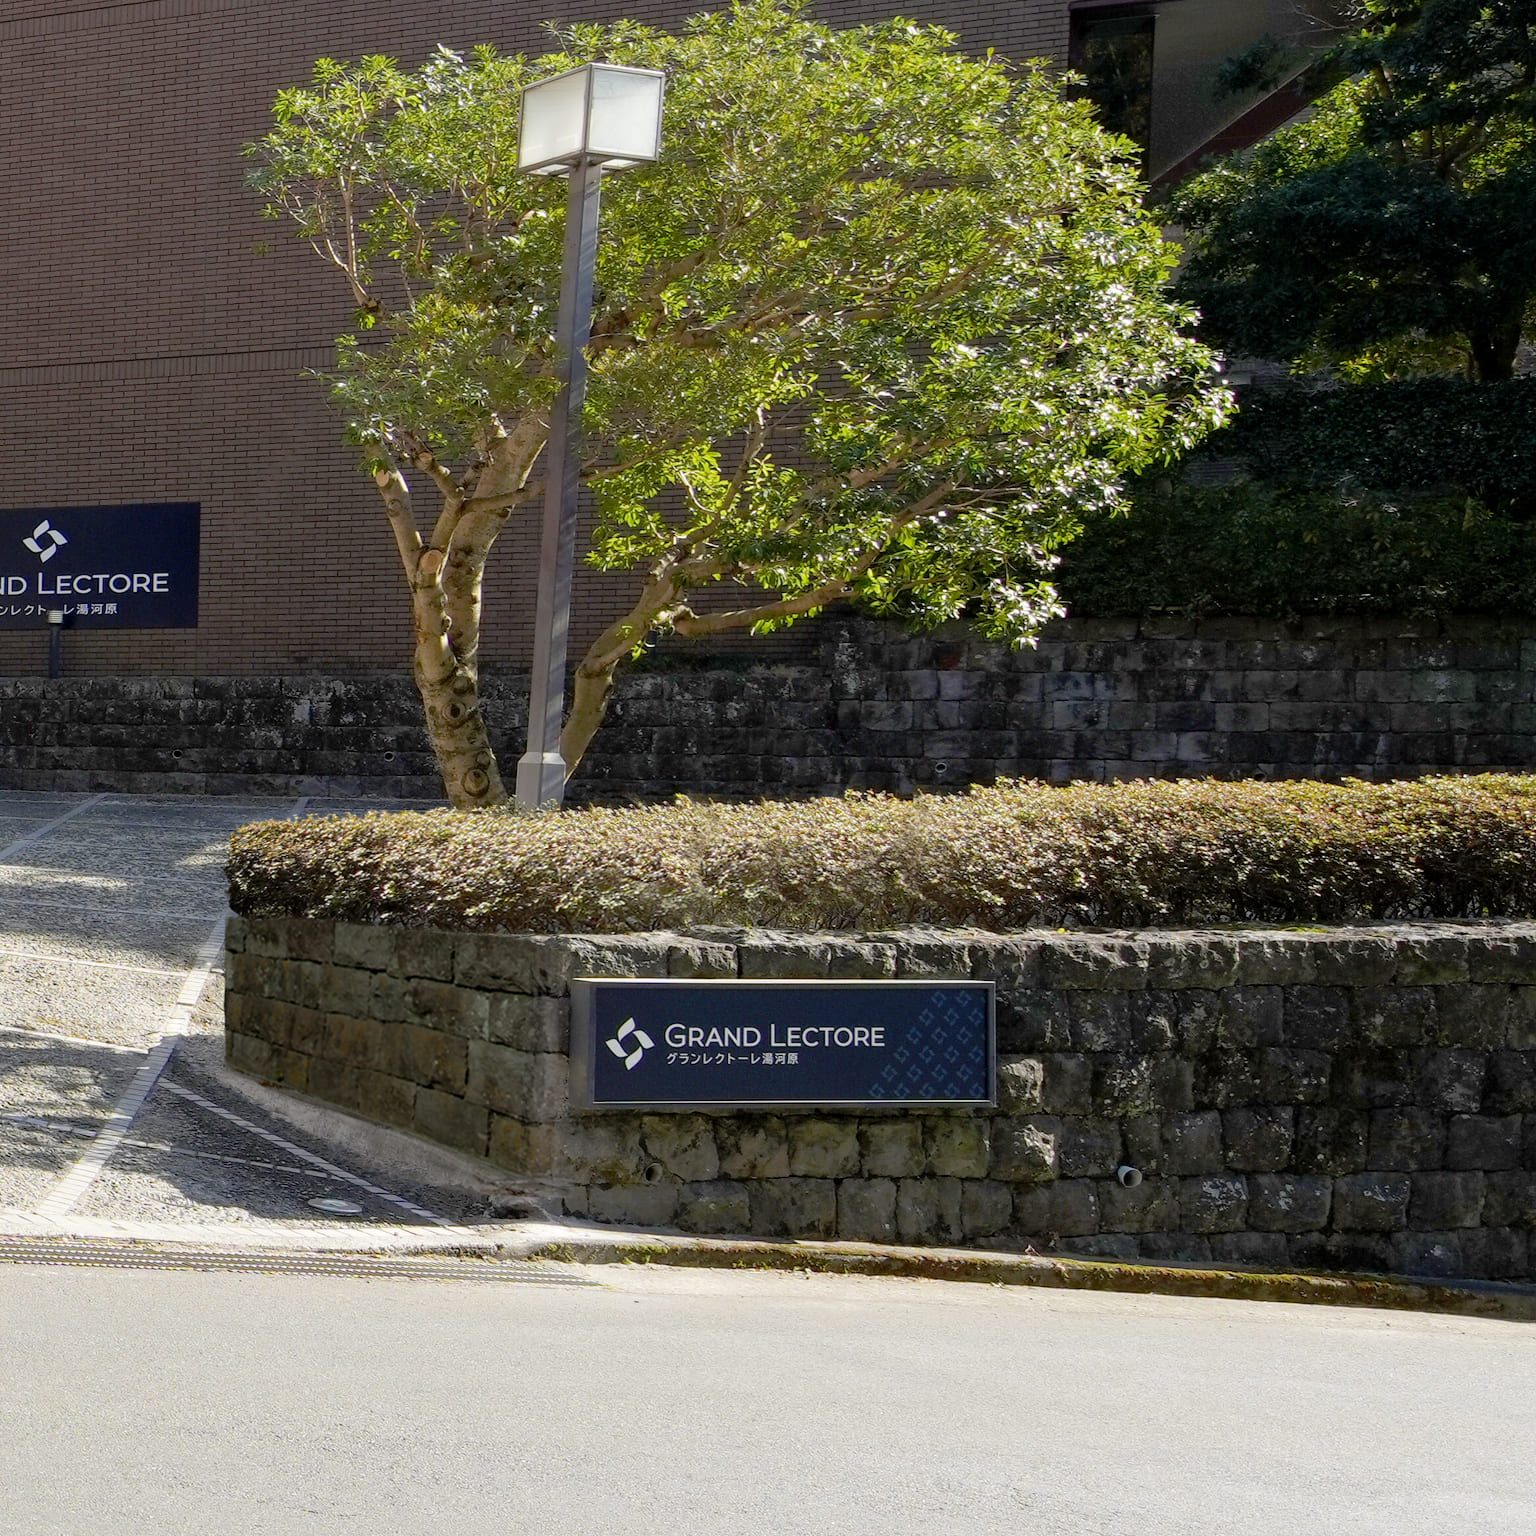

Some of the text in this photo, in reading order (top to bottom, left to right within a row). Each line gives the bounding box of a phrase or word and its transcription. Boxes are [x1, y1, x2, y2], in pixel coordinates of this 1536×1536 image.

[37, 572, 169, 596] LECTORE
[664, 1023, 885, 1047] GRAND LECTORE
[666, 1052, 799, 1066] グランレクトーレ湯河原
